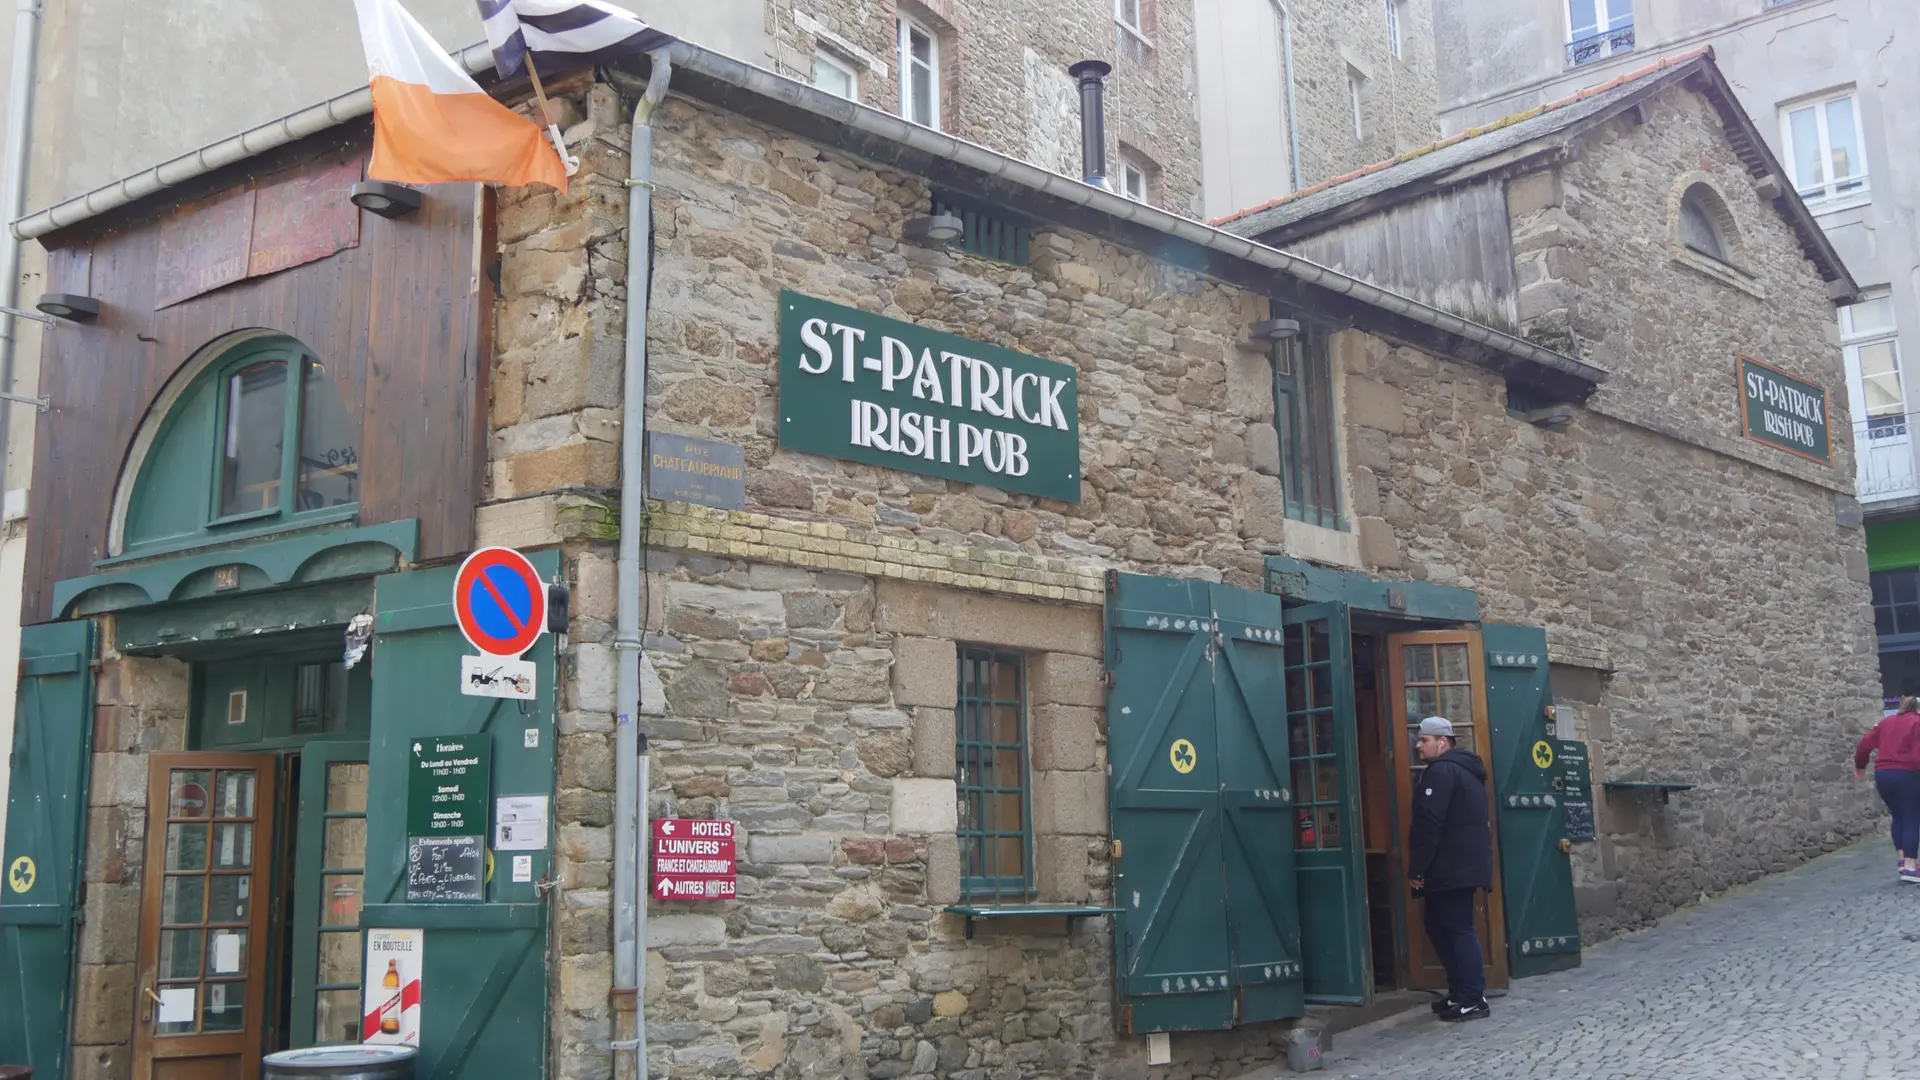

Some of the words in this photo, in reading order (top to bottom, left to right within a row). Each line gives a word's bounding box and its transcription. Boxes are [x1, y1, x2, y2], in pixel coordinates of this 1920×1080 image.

[200, 257, 240, 288] IRISH
[252, 245, 292, 271] PUB
[799, 318, 1069, 431] ST-PATRICK
[1747, 372, 1823, 425] ST-PATRICK
[1764, 410, 1793, 440] IRISH
[1793, 420, 1814, 447] PUB
[851, 399, 950, 463] IRISH
[958, 423, 1030, 477] PUB
[685, 445, 708, 456] RUE
[653, 454, 742, 480] CHATEAUBRIAND
[436, 743, 464, 752] Horaires
[453, 757, 479, 766] Vendredi
[433, 768, 448, 776] 11h00
[453, 767, 466, 775] 1h00
[438, 784, 459, 793] Samedi
[432, 794, 448, 802] 12h00
[452, 793, 465, 801] 1h00
[433, 811, 461, 820] Dimanche
[451, 820, 464, 828] 1h00
[691, 822, 731, 836] HOTELS
[658, 839, 719, 854] L'UNIVERS
[657, 858, 678, 872] FRANCE
[679, 859, 686, 872] ET
[674, 881, 704, 894] AUTRES
[705, 881, 735, 894] HOTELS
[374, 941, 381, 951] EN
[383, 941, 413, 951] BOUTEILLE
